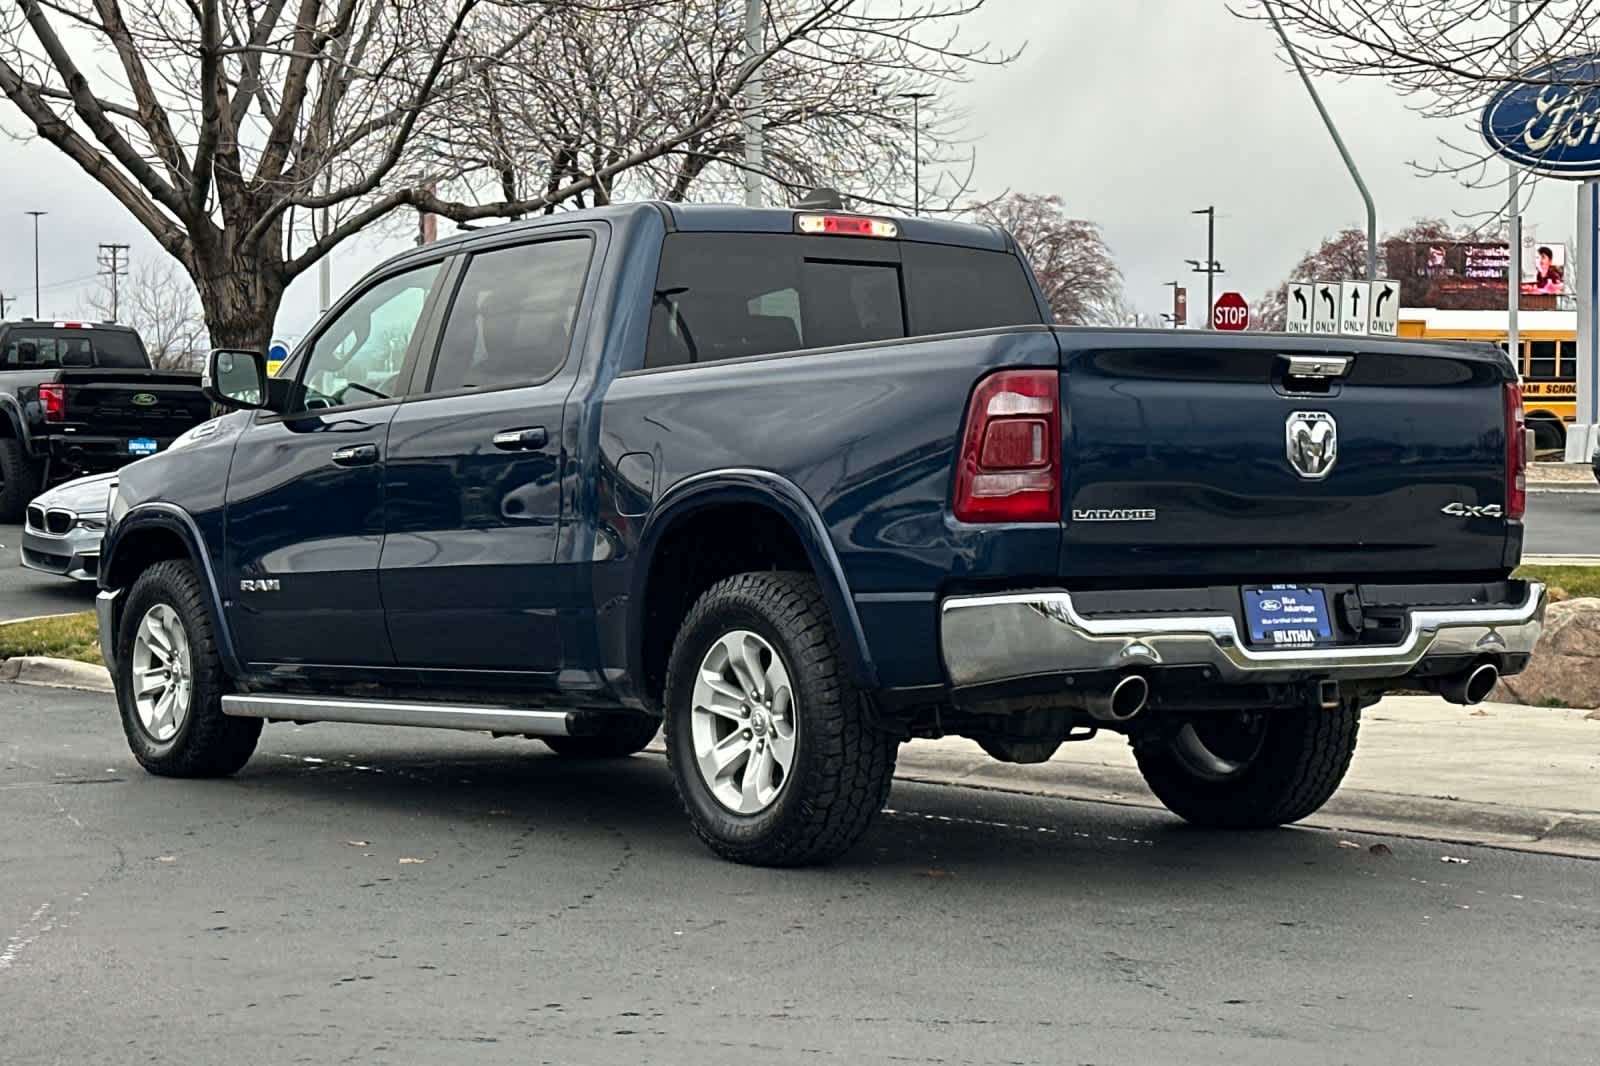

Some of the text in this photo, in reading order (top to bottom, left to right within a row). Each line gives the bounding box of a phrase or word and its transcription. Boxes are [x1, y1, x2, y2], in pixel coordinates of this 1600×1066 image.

[1215, 307, 1247, 325] STOP
[1289, 323, 1308, 333] ONLY
[1315, 323, 1336, 333] ONLY
[1344, 322, 1364, 332] ONLY
[1372, 322, 1394, 332] ONLY
[1072, 509, 1156, 520] LARAMIE
[240, 580, 280, 591] RAM
[1282, 630, 1315, 642] LITHIA
